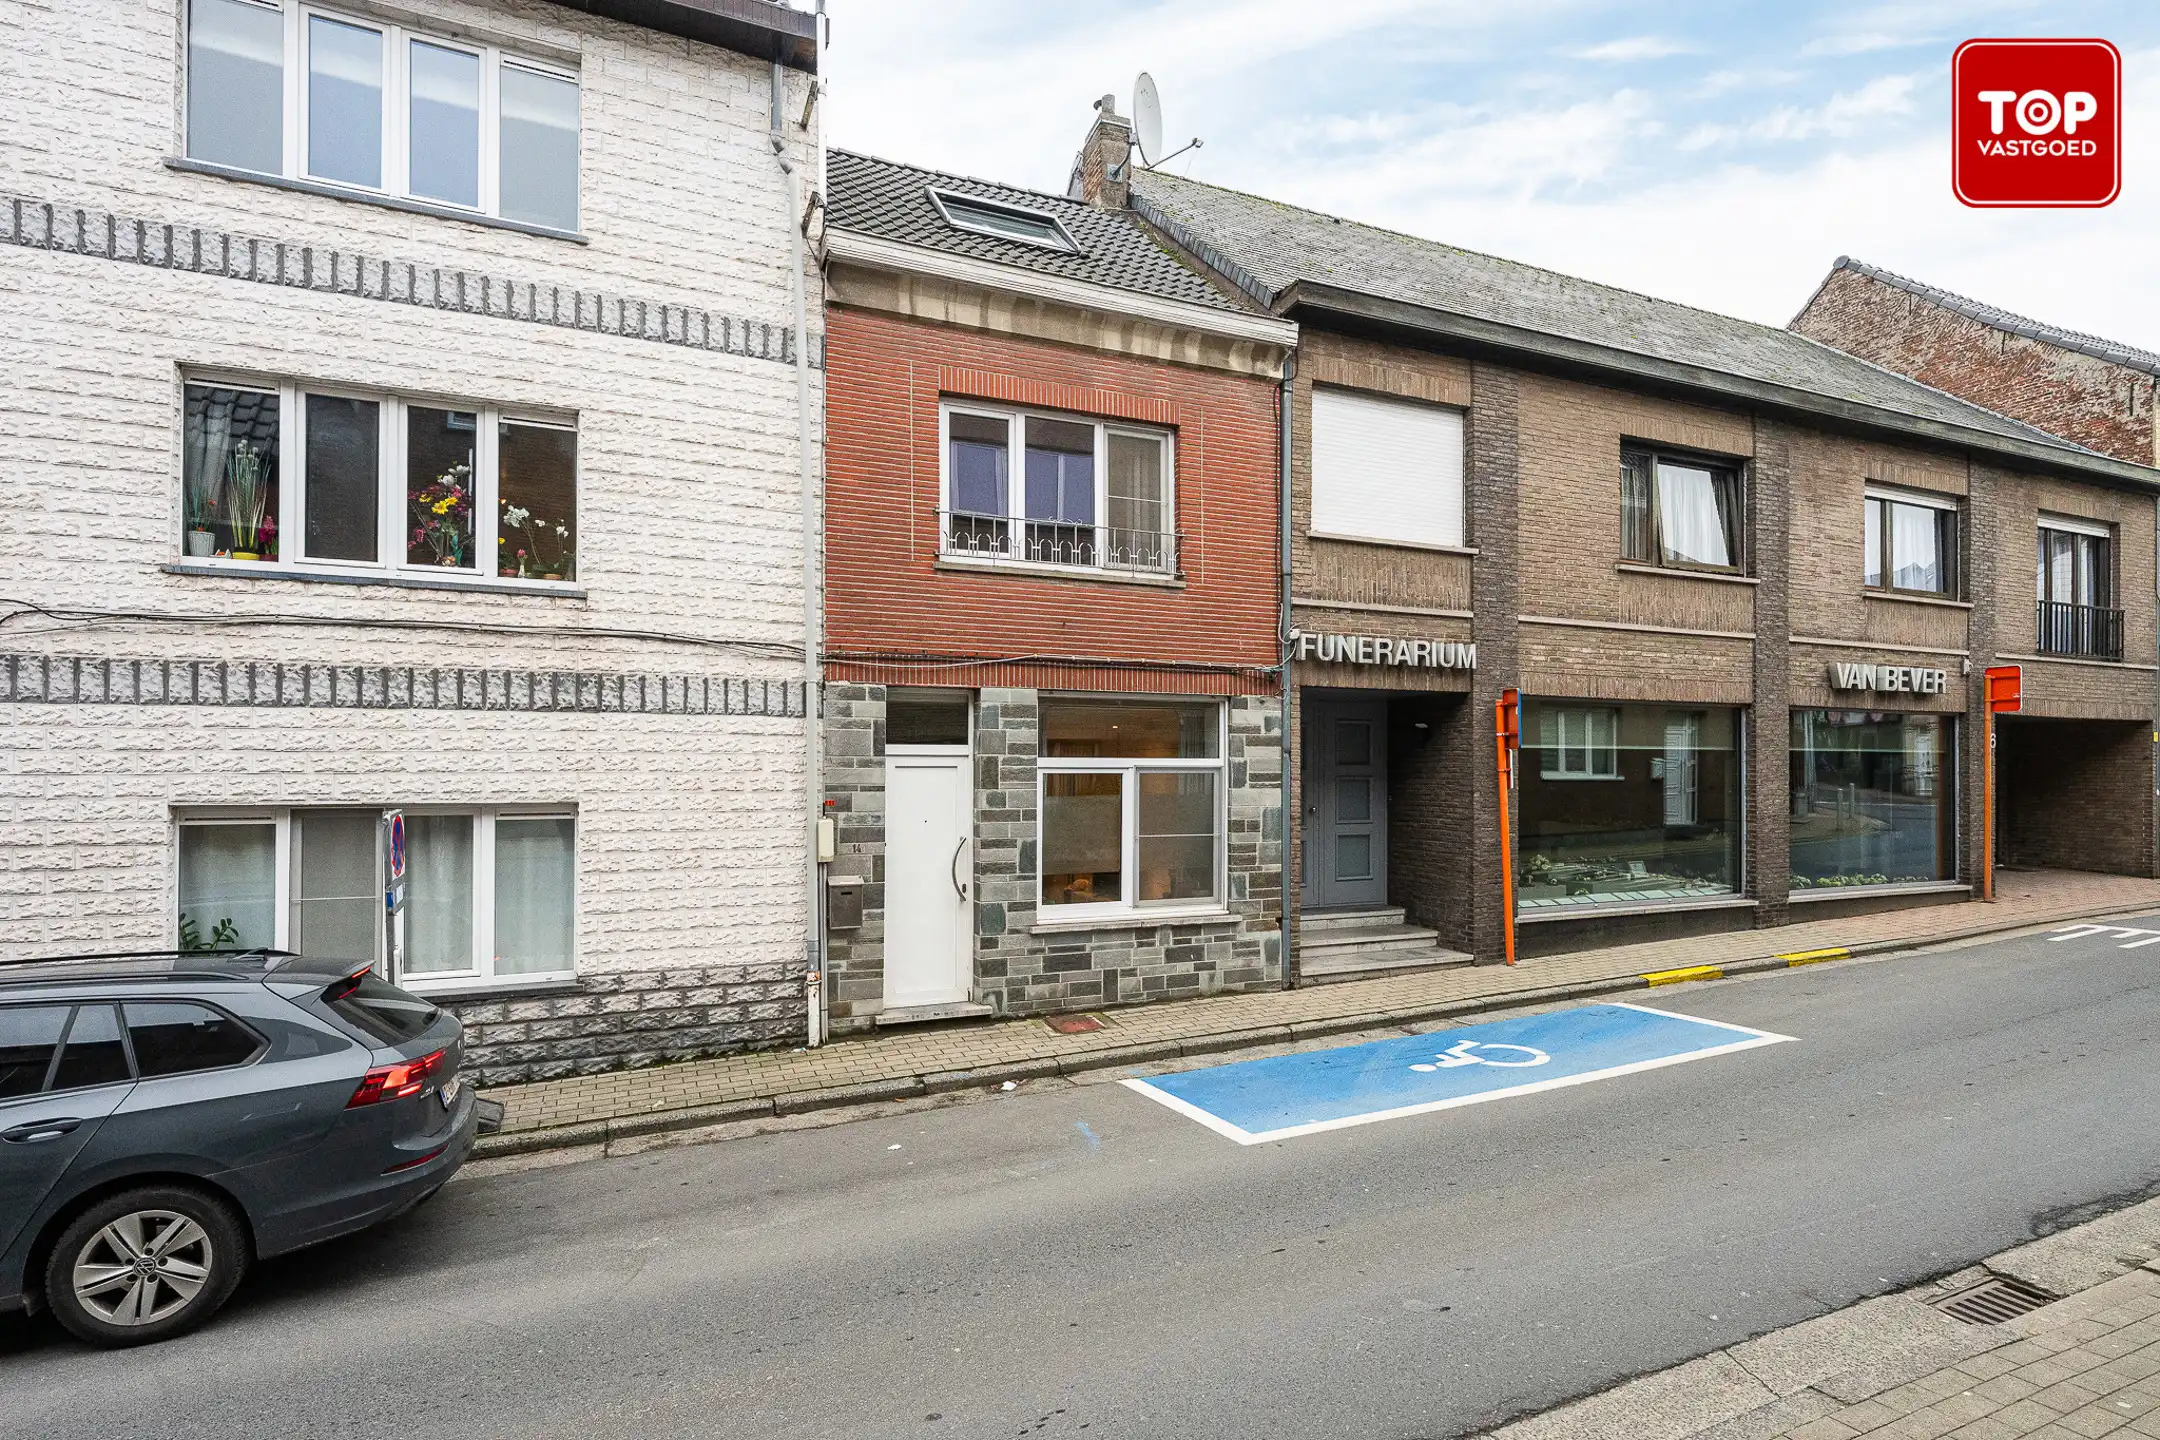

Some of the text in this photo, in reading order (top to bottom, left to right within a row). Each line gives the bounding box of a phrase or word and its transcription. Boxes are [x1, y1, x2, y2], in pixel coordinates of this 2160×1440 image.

[1297, 633, 1477, 669] FUNERARIUM
[1835, 662, 1947, 694] VAN BEVER
